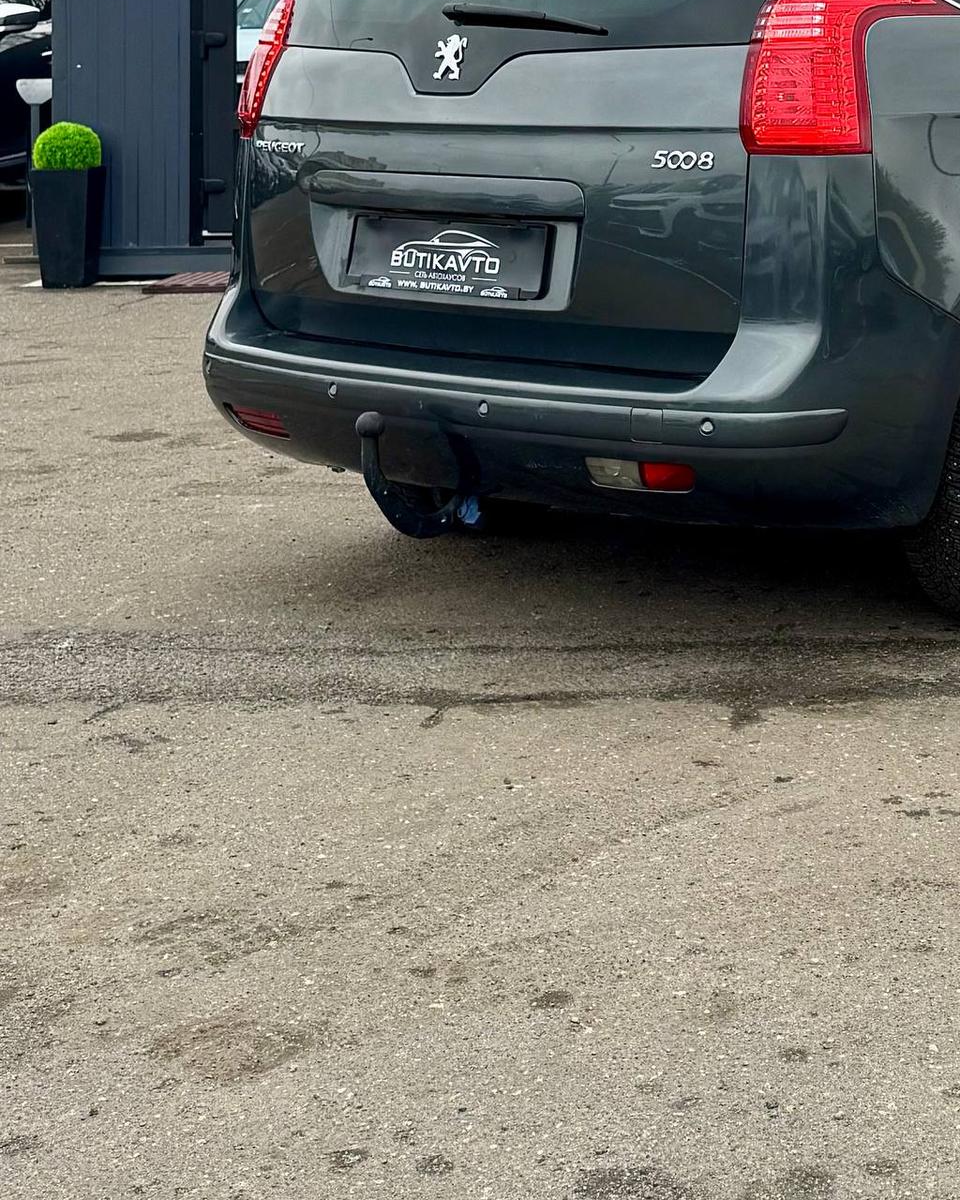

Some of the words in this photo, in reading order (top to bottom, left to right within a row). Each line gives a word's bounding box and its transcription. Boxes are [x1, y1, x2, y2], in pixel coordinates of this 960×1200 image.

[256, 140, 305, 153] PEUGEOT
[651, 150, 714, 170] 5008
[390, 249, 500, 274] BUTIKAVTO
